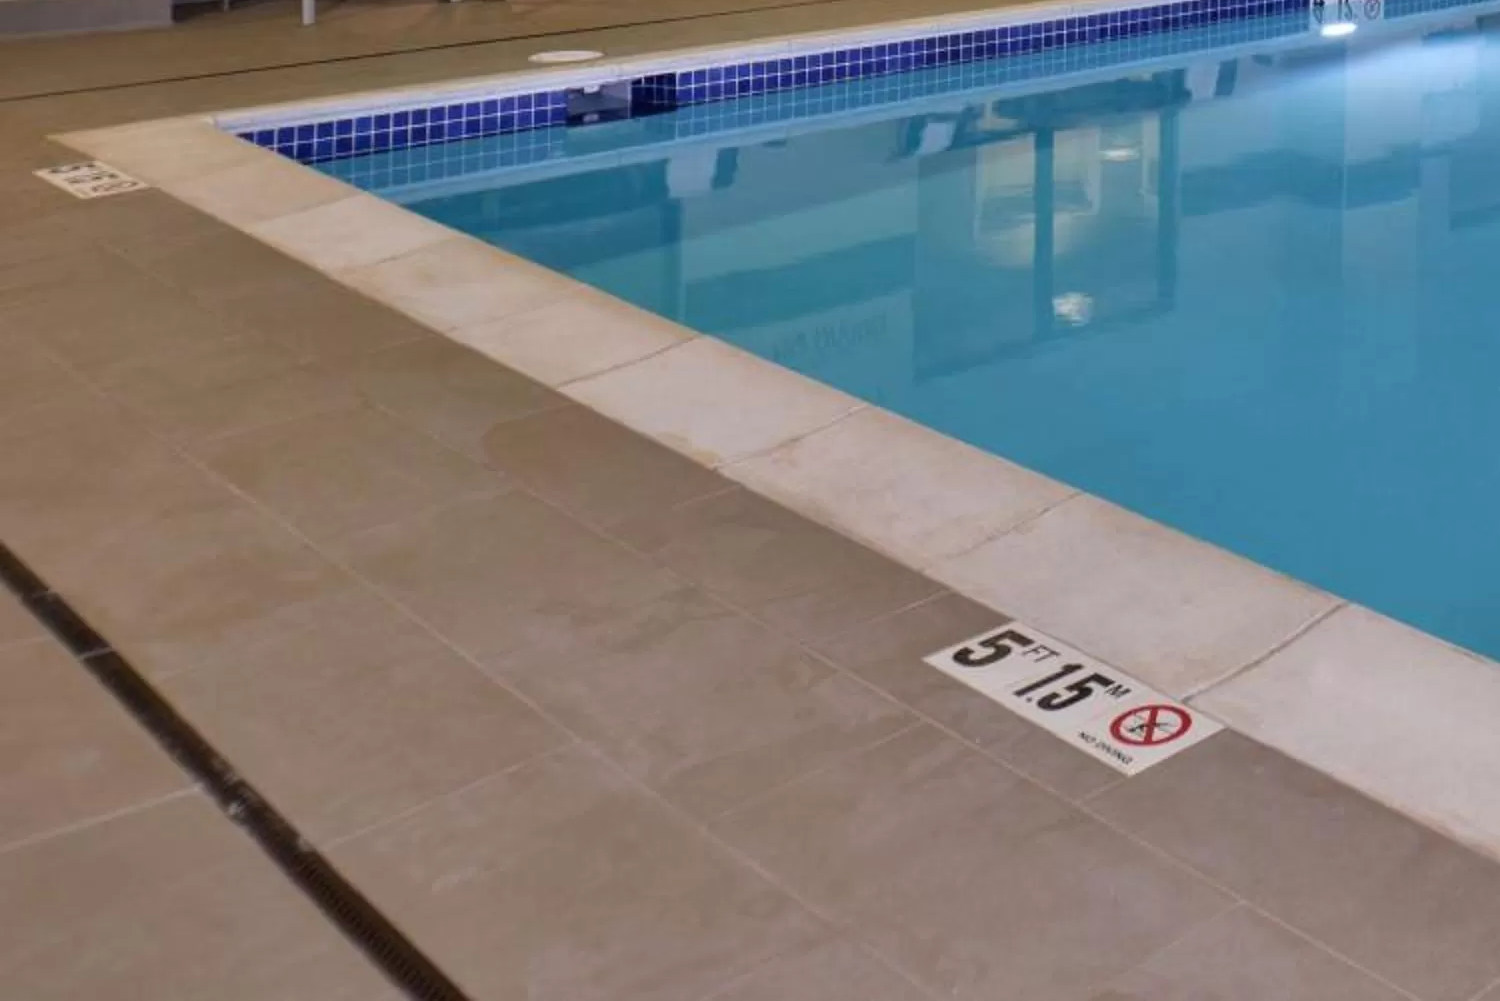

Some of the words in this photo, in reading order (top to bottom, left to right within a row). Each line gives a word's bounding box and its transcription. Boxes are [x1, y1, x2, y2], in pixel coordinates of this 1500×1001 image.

[952, 628, 1036, 668] 5
[1022, 644, 1061, 664] FT
[1013, 662, 1115, 712] 1.5
[1104, 683, 1132, 699] M
